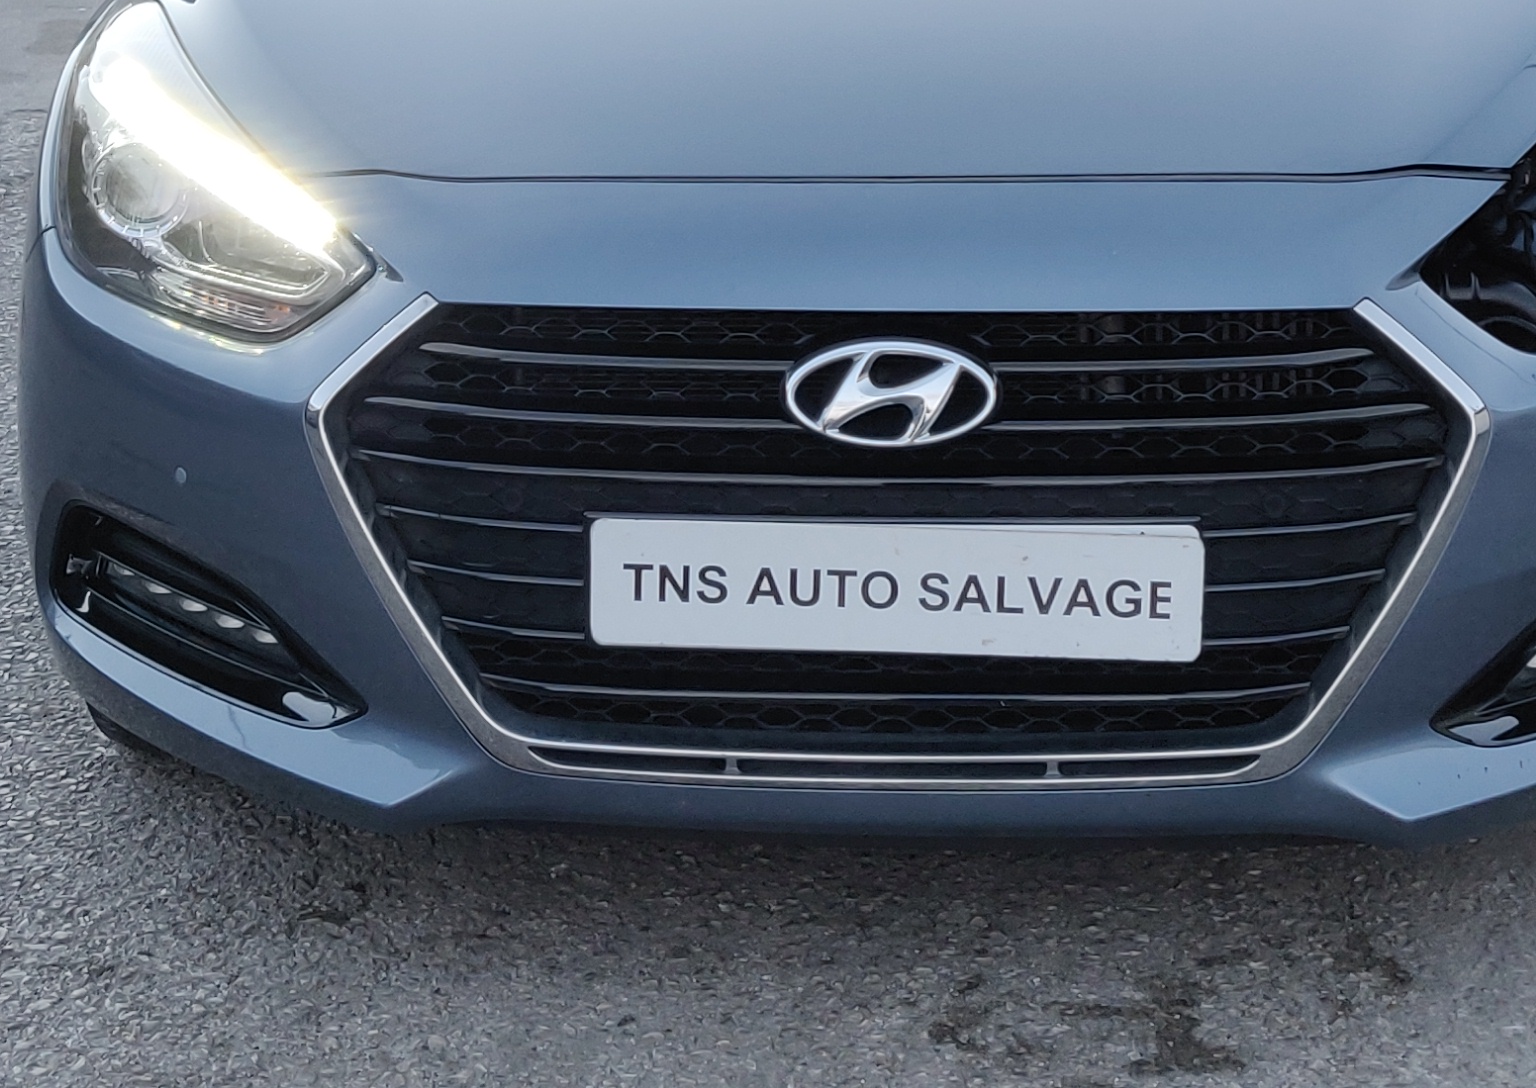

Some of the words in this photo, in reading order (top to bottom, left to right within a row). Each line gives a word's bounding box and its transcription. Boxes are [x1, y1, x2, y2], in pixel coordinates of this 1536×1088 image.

[622, 562, 729, 605] TNS
[744, 566, 900, 610] AUTO
[917, 571, 1173, 620] SALVAGE
